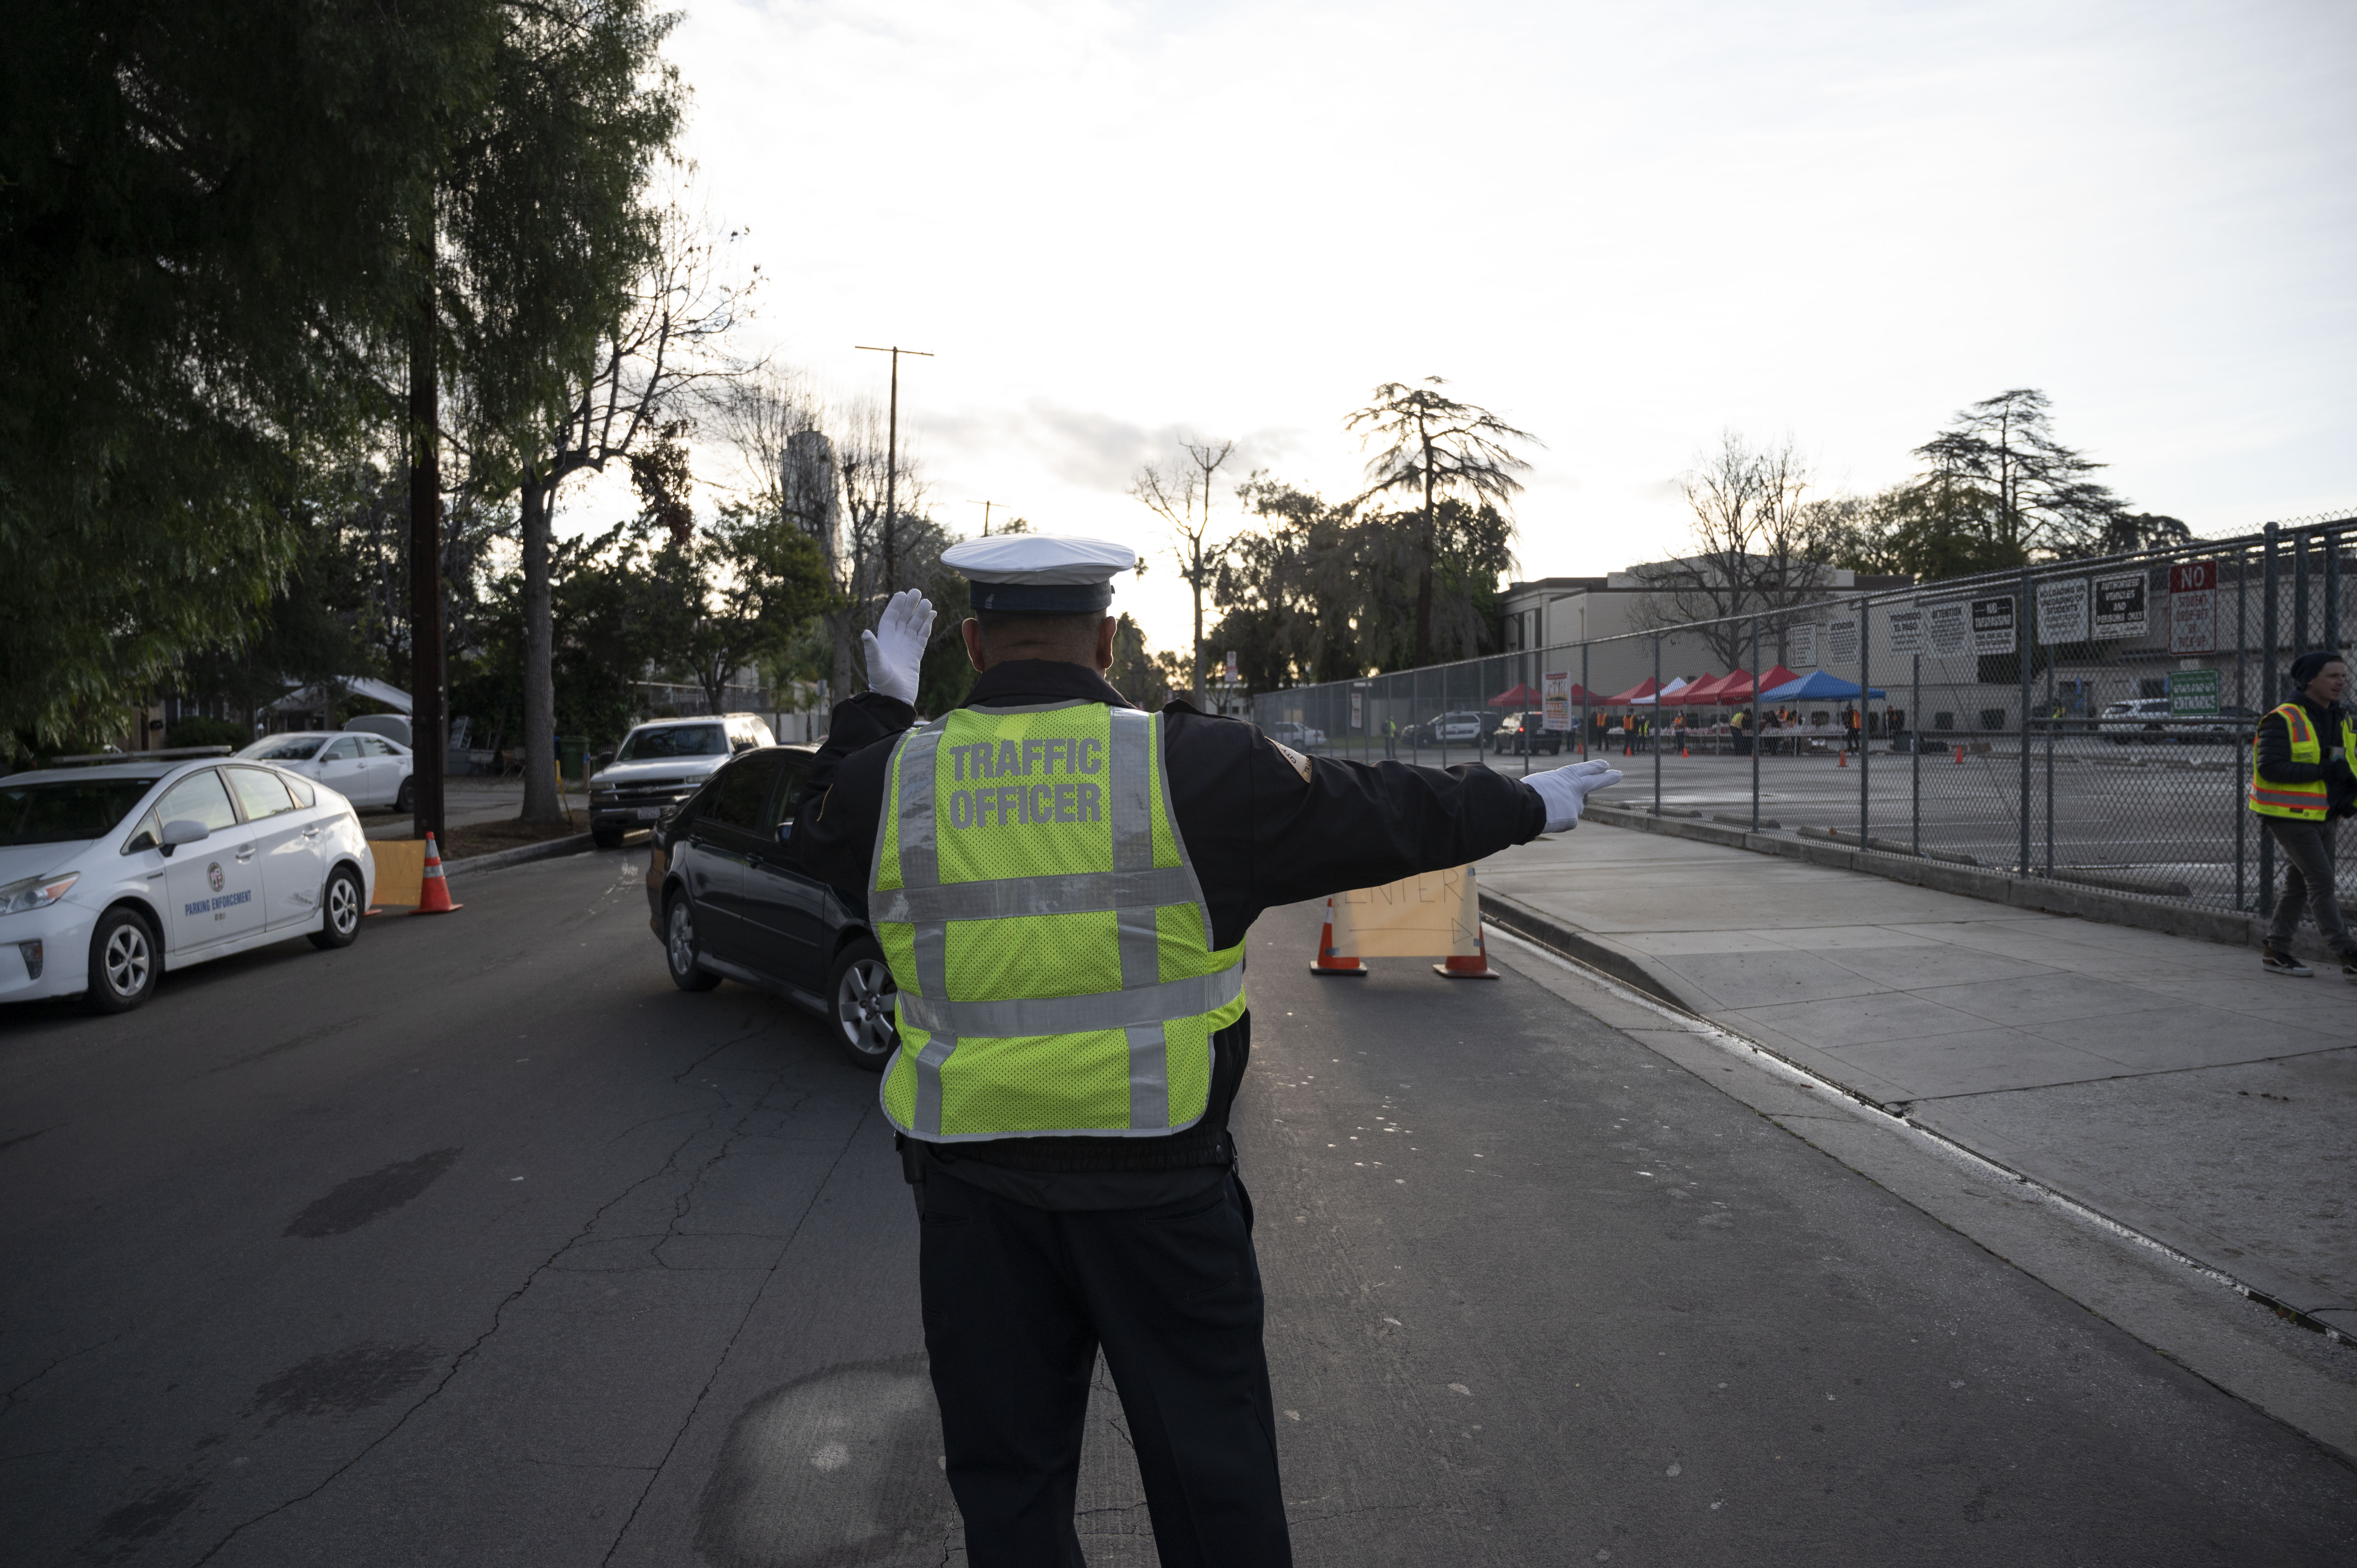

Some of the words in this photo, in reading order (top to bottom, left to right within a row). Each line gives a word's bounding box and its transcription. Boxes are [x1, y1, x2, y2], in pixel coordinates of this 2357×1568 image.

[2181, 566, 2205, 589] NO
[2101, 578, 2140, 590] AUTHORIZED
[2049, 586, 2075, 596] LOADING
[2105, 590, 2135, 601] VEHICLES
[2040, 595, 2074, 606] UNLOADING
[2113, 602, 2127, 611] AND
[2178, 594, 2208, 607] STUDENT
[1933, 607, 1962, 618] ATTENTION
[1986, 602, 1997, 614] NO
[2046, 604, 2078, 614] STUDENTS
[1890, 612, 1921, 622] PROHIBIDO
[1975, 614, 2011, 628] TRESPASSING
[2097, 613, 2125, 623] PERSONS
[2127, 611, 2143, 620] ONLY
[2176, 609, 2209, 622] DROP-OFF
[1902, 623, 1918, 631] PASO
[2188, 623, 2197, 633] OR
[2178, 636, 2206, 648] PICK-UP
[949, 738, 1103, 781] TRAFFIC
[1281, 749, 1297, 764] CITY
[949, 783, 1103, 830] OFFICER
[185, 899, 210, 916] PARKING
[212, 890, 251, 910] ENFORCEMENT
